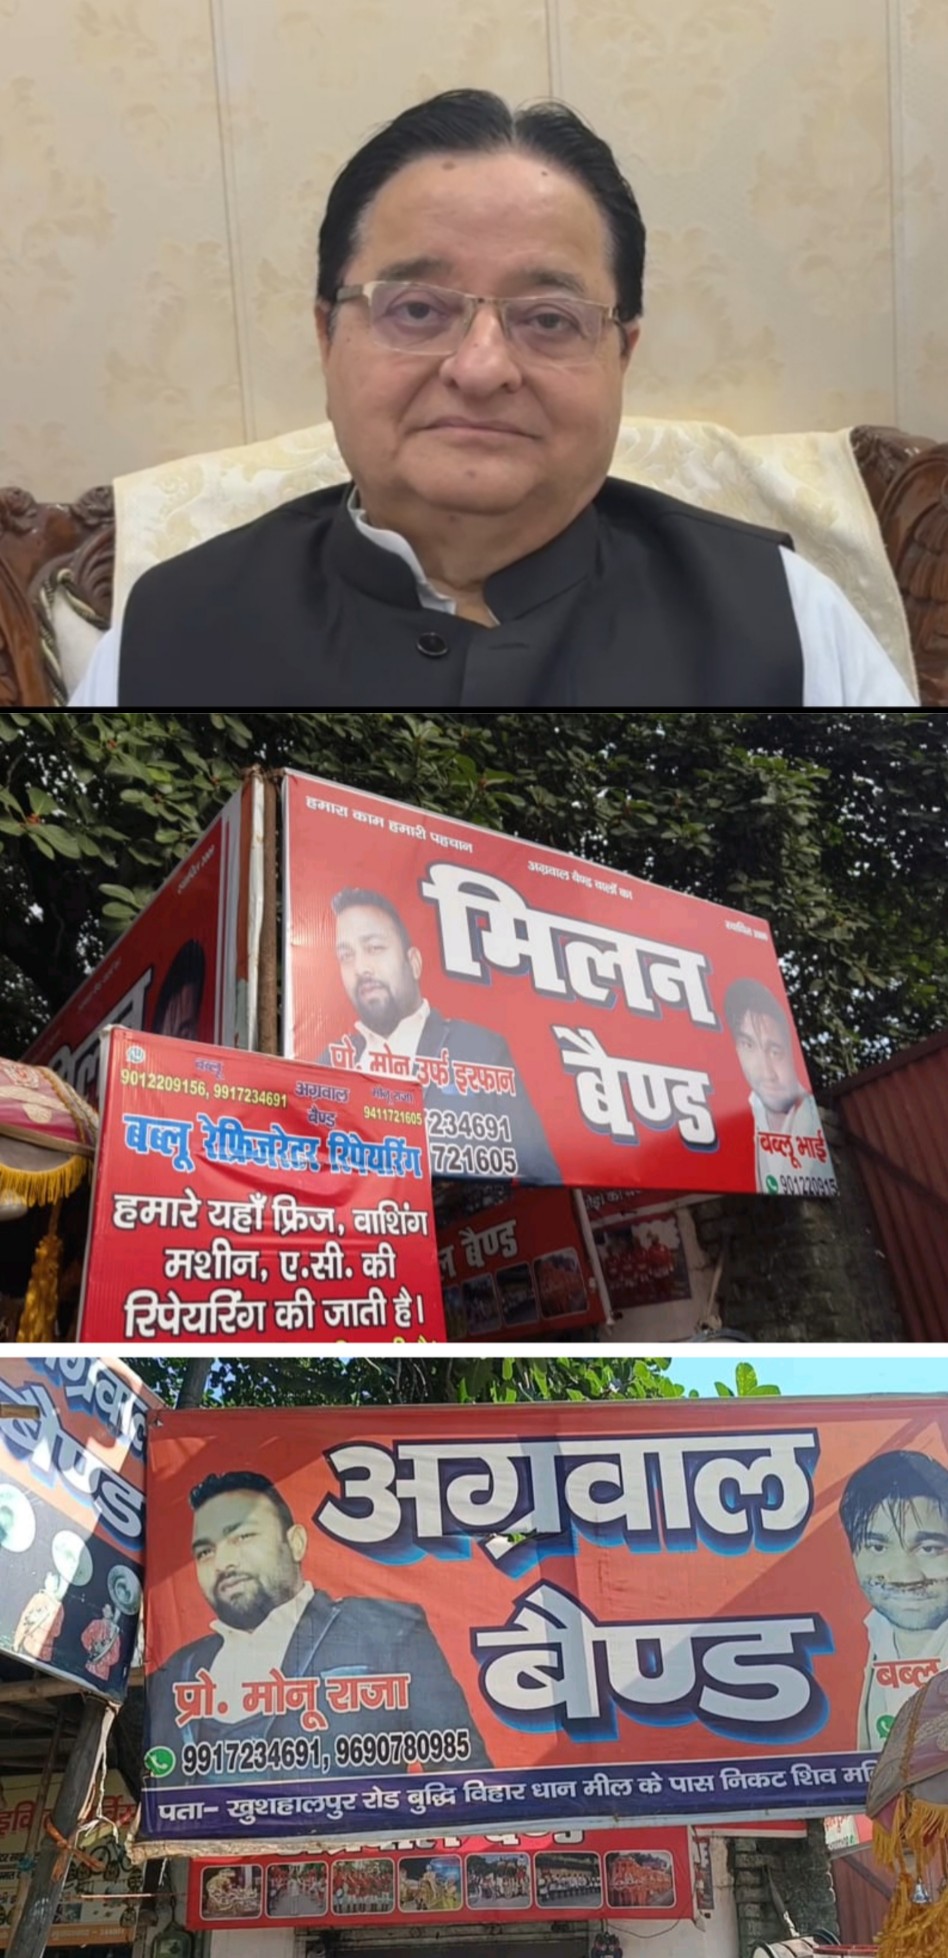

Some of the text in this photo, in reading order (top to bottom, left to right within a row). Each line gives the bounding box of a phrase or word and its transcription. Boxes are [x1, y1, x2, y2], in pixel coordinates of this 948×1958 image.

[305, 795, 473, 853] हमारा काम हमारी पहचान
[421, 862, 720, 1028] मिलन
[120, 1067, 287, 1108] 9012209156, 9917234691
[295, 1081, 350, 1103] अग्रवाल
[415, 1047, 449, 1087] उर्फ
[452, 1060, 516, 1096] इरफान
[551, 1025, 718, 1146] बैण्ड
[308, 1103, 336, 1128] बैण्ड
[363, 1105, 423, 1126] 9411721605
[122, 1113, 196, 1173] बब्लू
[328, 1130, 423, 1178] रिपेयरिंग
[431, 1143, 518, 1175] 721605
[758, 1129, 827, 1168] बब्लू भाई
[112, 1187, 428, 1236] हमारे यहाँ फ्रिज, वाशिंग
[163, 1238, 268, 1283] मशीन,
[277, 1239, 353, 1282] ए.सी.
[361, 1241, 397, 1281] की
[459, 1219, 517, 1268] बैण्ड
[124, 1286, 425, 1338] रिपेयरिंग की जाती है।
[315, 1430, 818, 1562] अग्रवाल
[474, 1582, 820, 1727] बैण्ड
[173, 1667, 410, 1731] प्रो. मोनू राजा
[183, 1728, 471, 1776] 9917234691, 9690780985
[227, 1792, 358, 1825] खुशहालपुर
[363, 1785, 400, 1810] रोड
[406, 1781, 457, 1814] बुद्धि
[464, 1778, 525, 1803] विहार
[533, 1780, 577, 1798] धान
[583, 1771, 633, 1796] मील
[638, 1773, 663, 1795] के
[670, 1774, 714, 1793] पास
[720, 1767, 788, 1791] निकट
[791, 1763, 837, 1786] शिव
